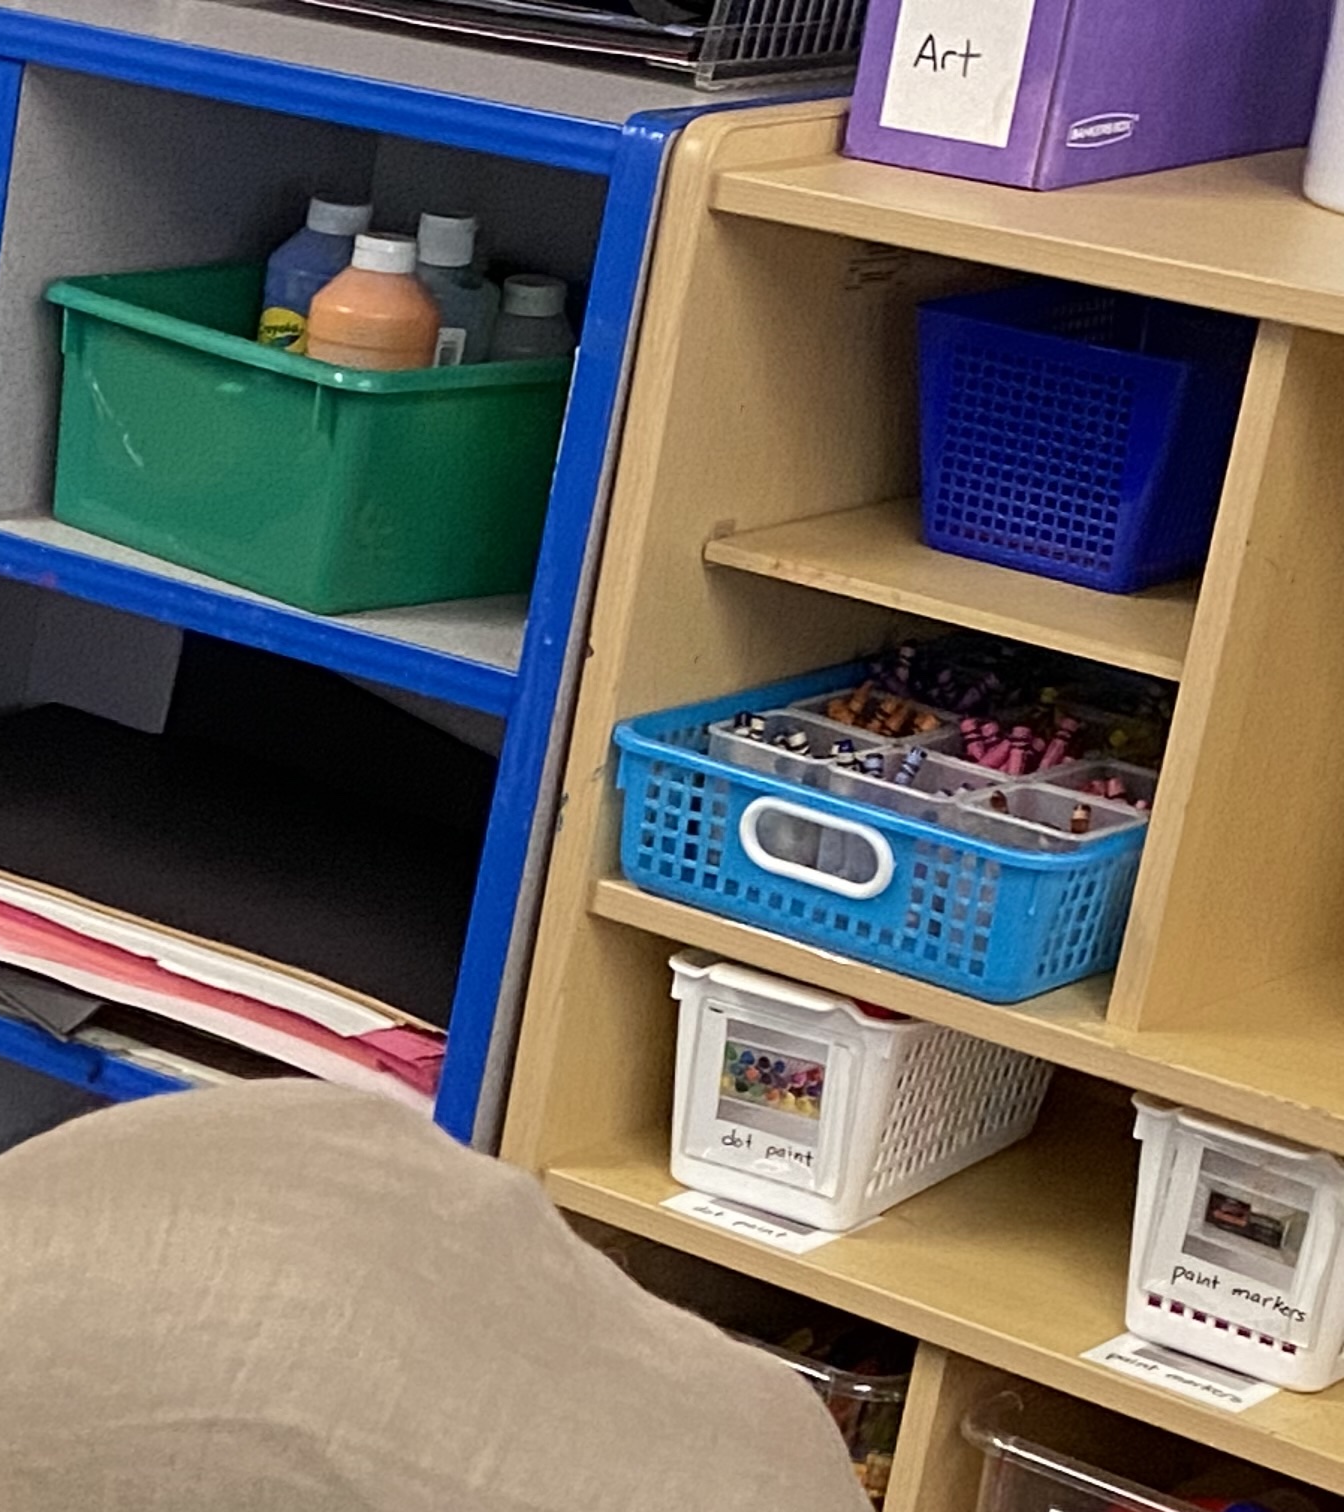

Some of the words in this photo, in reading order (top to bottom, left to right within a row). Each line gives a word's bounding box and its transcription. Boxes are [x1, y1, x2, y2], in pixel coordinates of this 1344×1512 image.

[913, 33, 982, 78] Art
[721, 1129, 752, 1148] dot
[765, 1146, 814, 1167] paint
[692, 1206, 724, 1217] dot
[732, 1220, 787, 1238] paint
[1171, 1266, 1221, 1289] paint
[1232, 1287, 1307, 1323] markers
[1105, 1352, 1160, 1371] paint
[1166, 1373, 1243, 1404] markers
